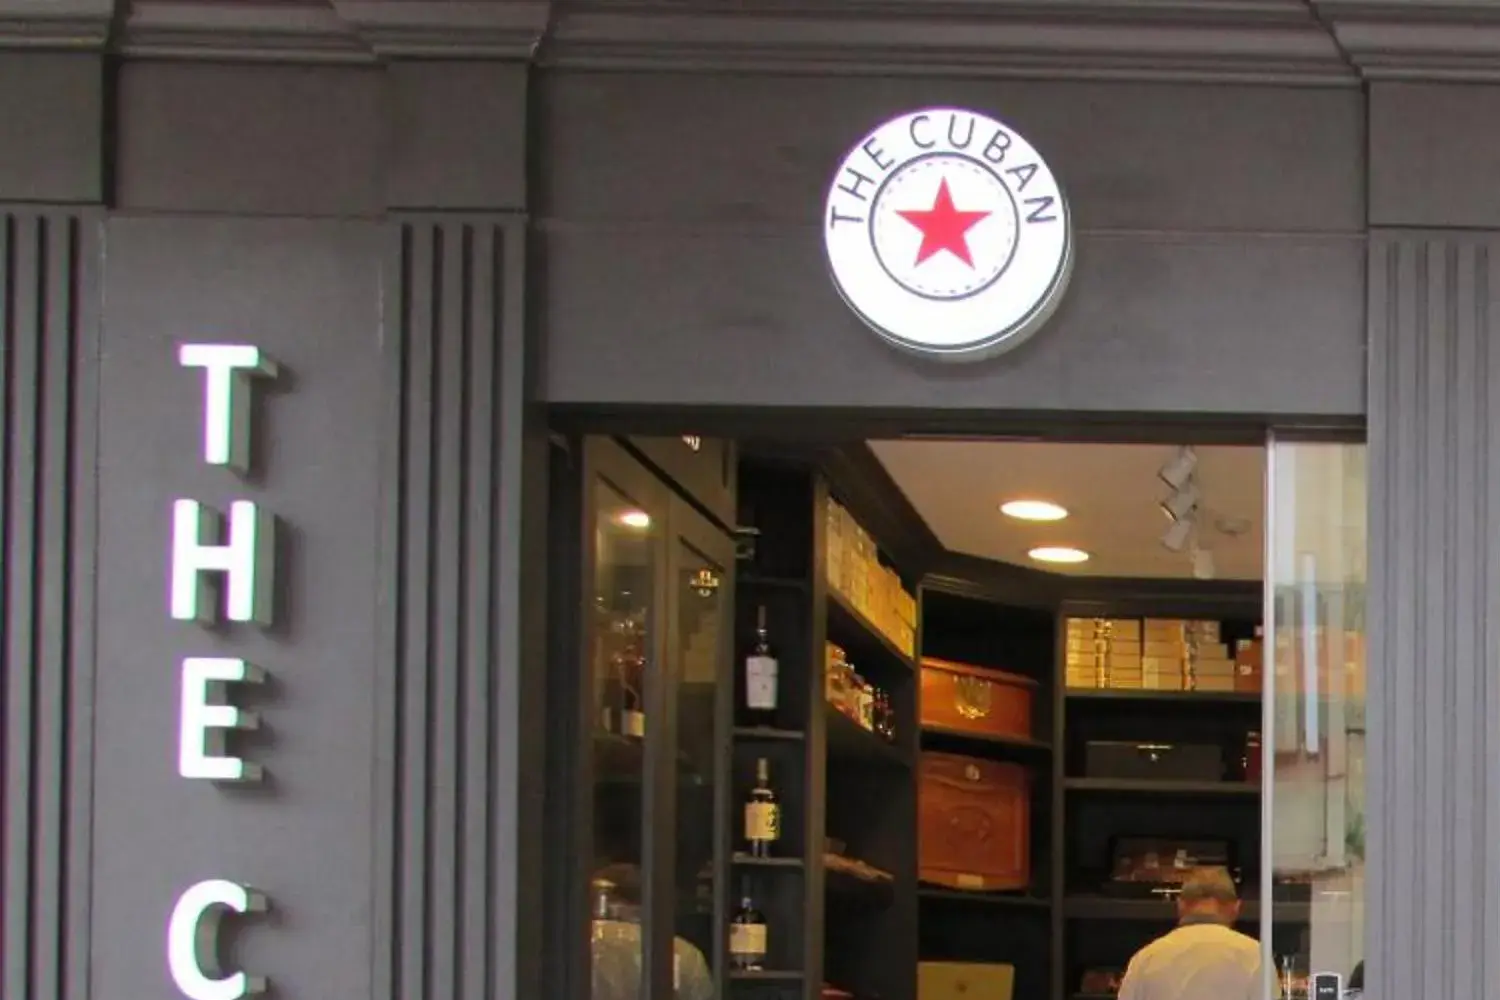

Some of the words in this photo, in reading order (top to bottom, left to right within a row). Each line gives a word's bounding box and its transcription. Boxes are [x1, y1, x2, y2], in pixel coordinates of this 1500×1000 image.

[830, 137, 895, 229] THE
[909, 114, 1057, 224] CUBAN
[170, 344, 260, 779] THE
